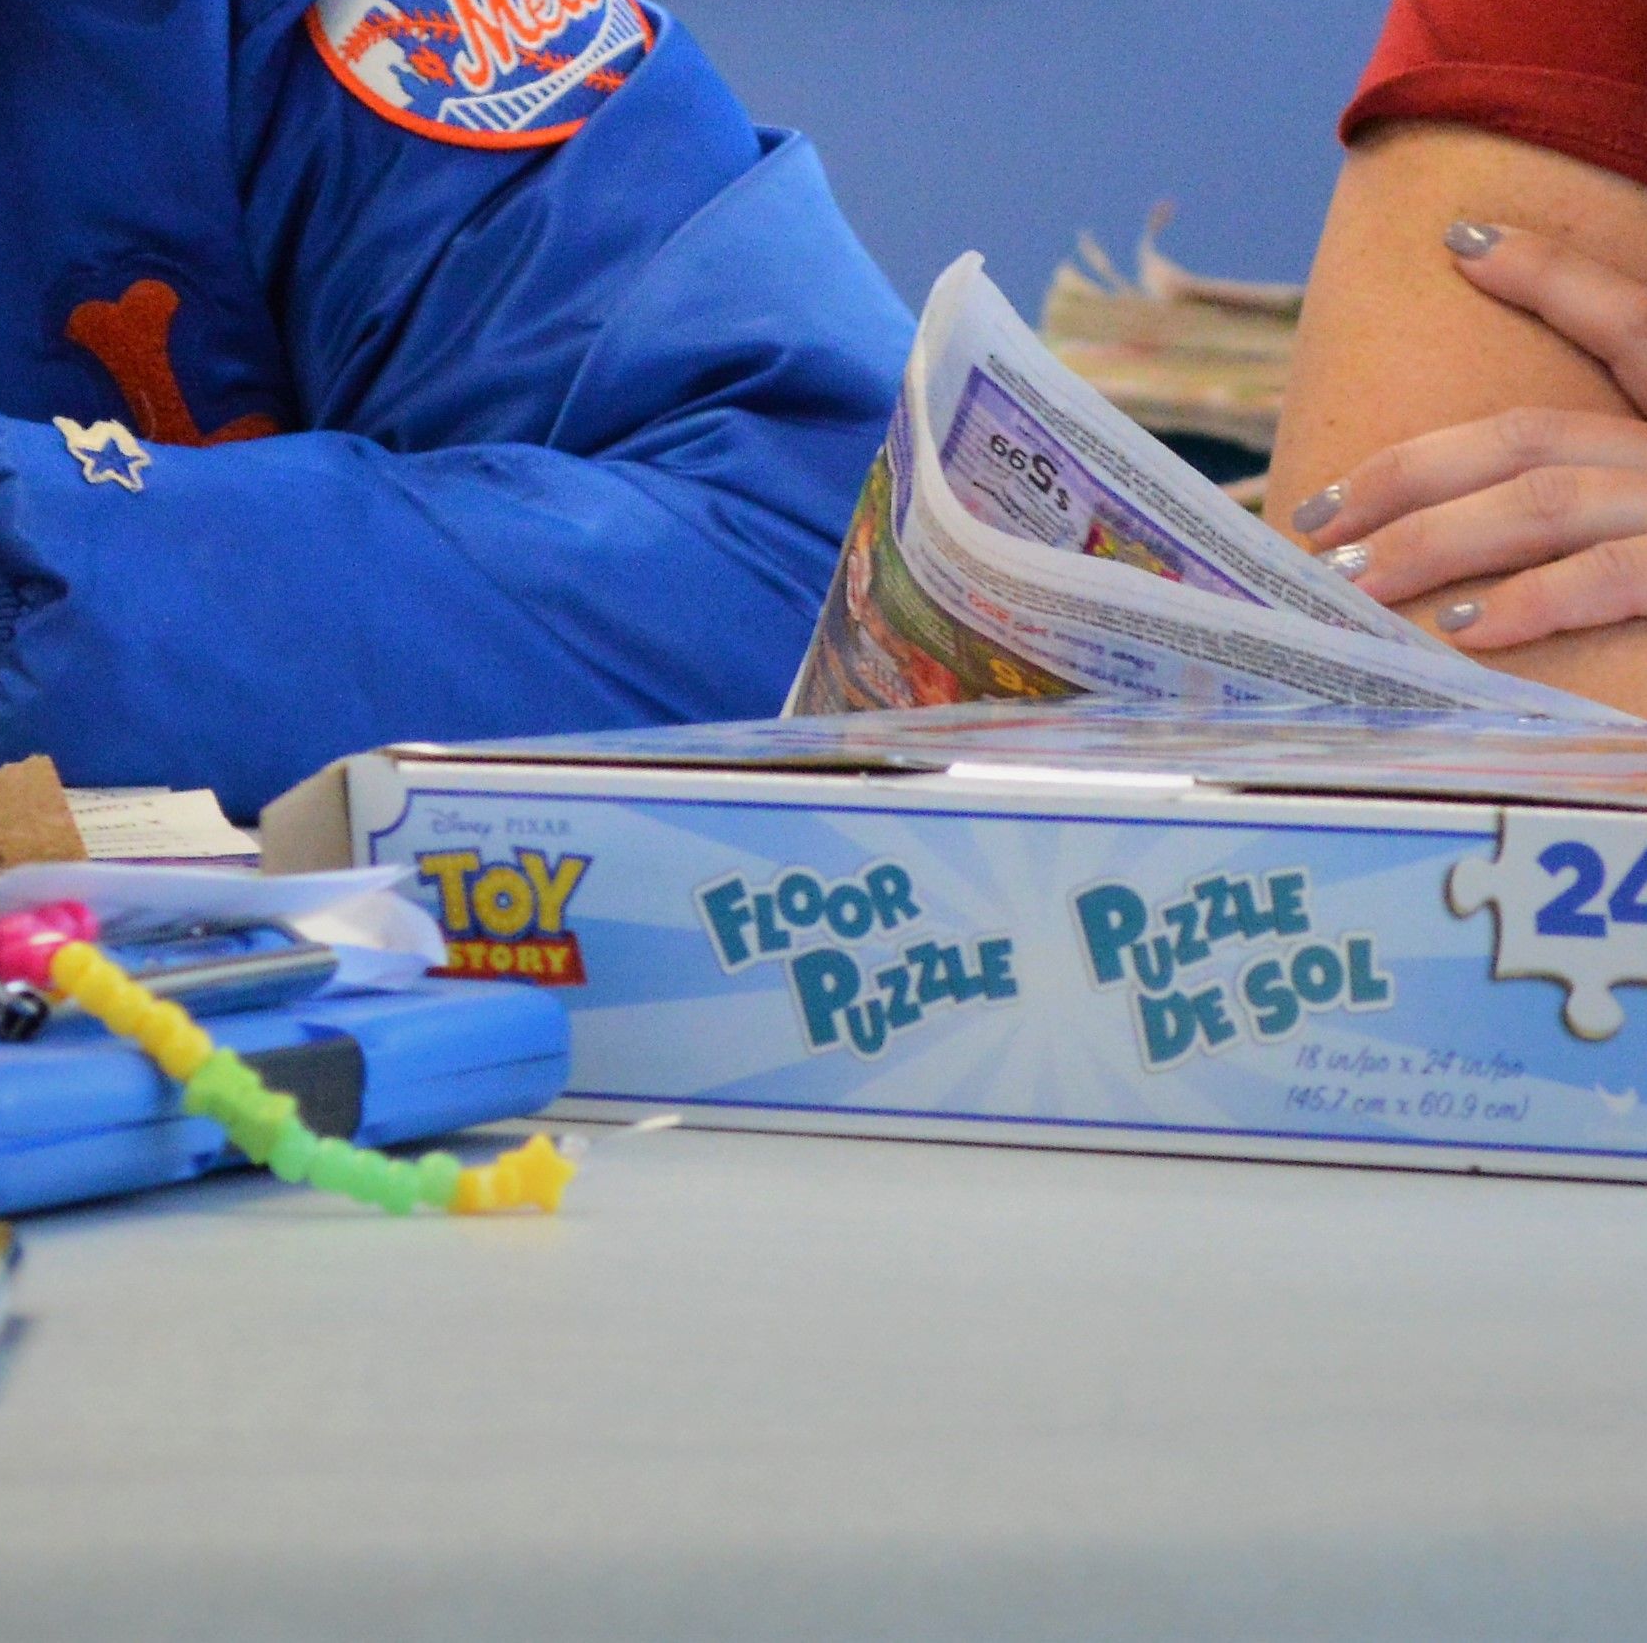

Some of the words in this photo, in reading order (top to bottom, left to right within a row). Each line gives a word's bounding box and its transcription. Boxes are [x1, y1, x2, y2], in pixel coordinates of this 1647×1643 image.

[415, 846, 593, 941] TOY
[702, 862, 921, 966] FLOOR
[1077, 872, 1309, 991] PUZZLE
[447, 941, 570, 974] STORY
[792, 939, 1017, 1054] PUZZLE
[1139, 985, 1236, 1063] DE
[1244, 938, 1388, 1036] SOL
